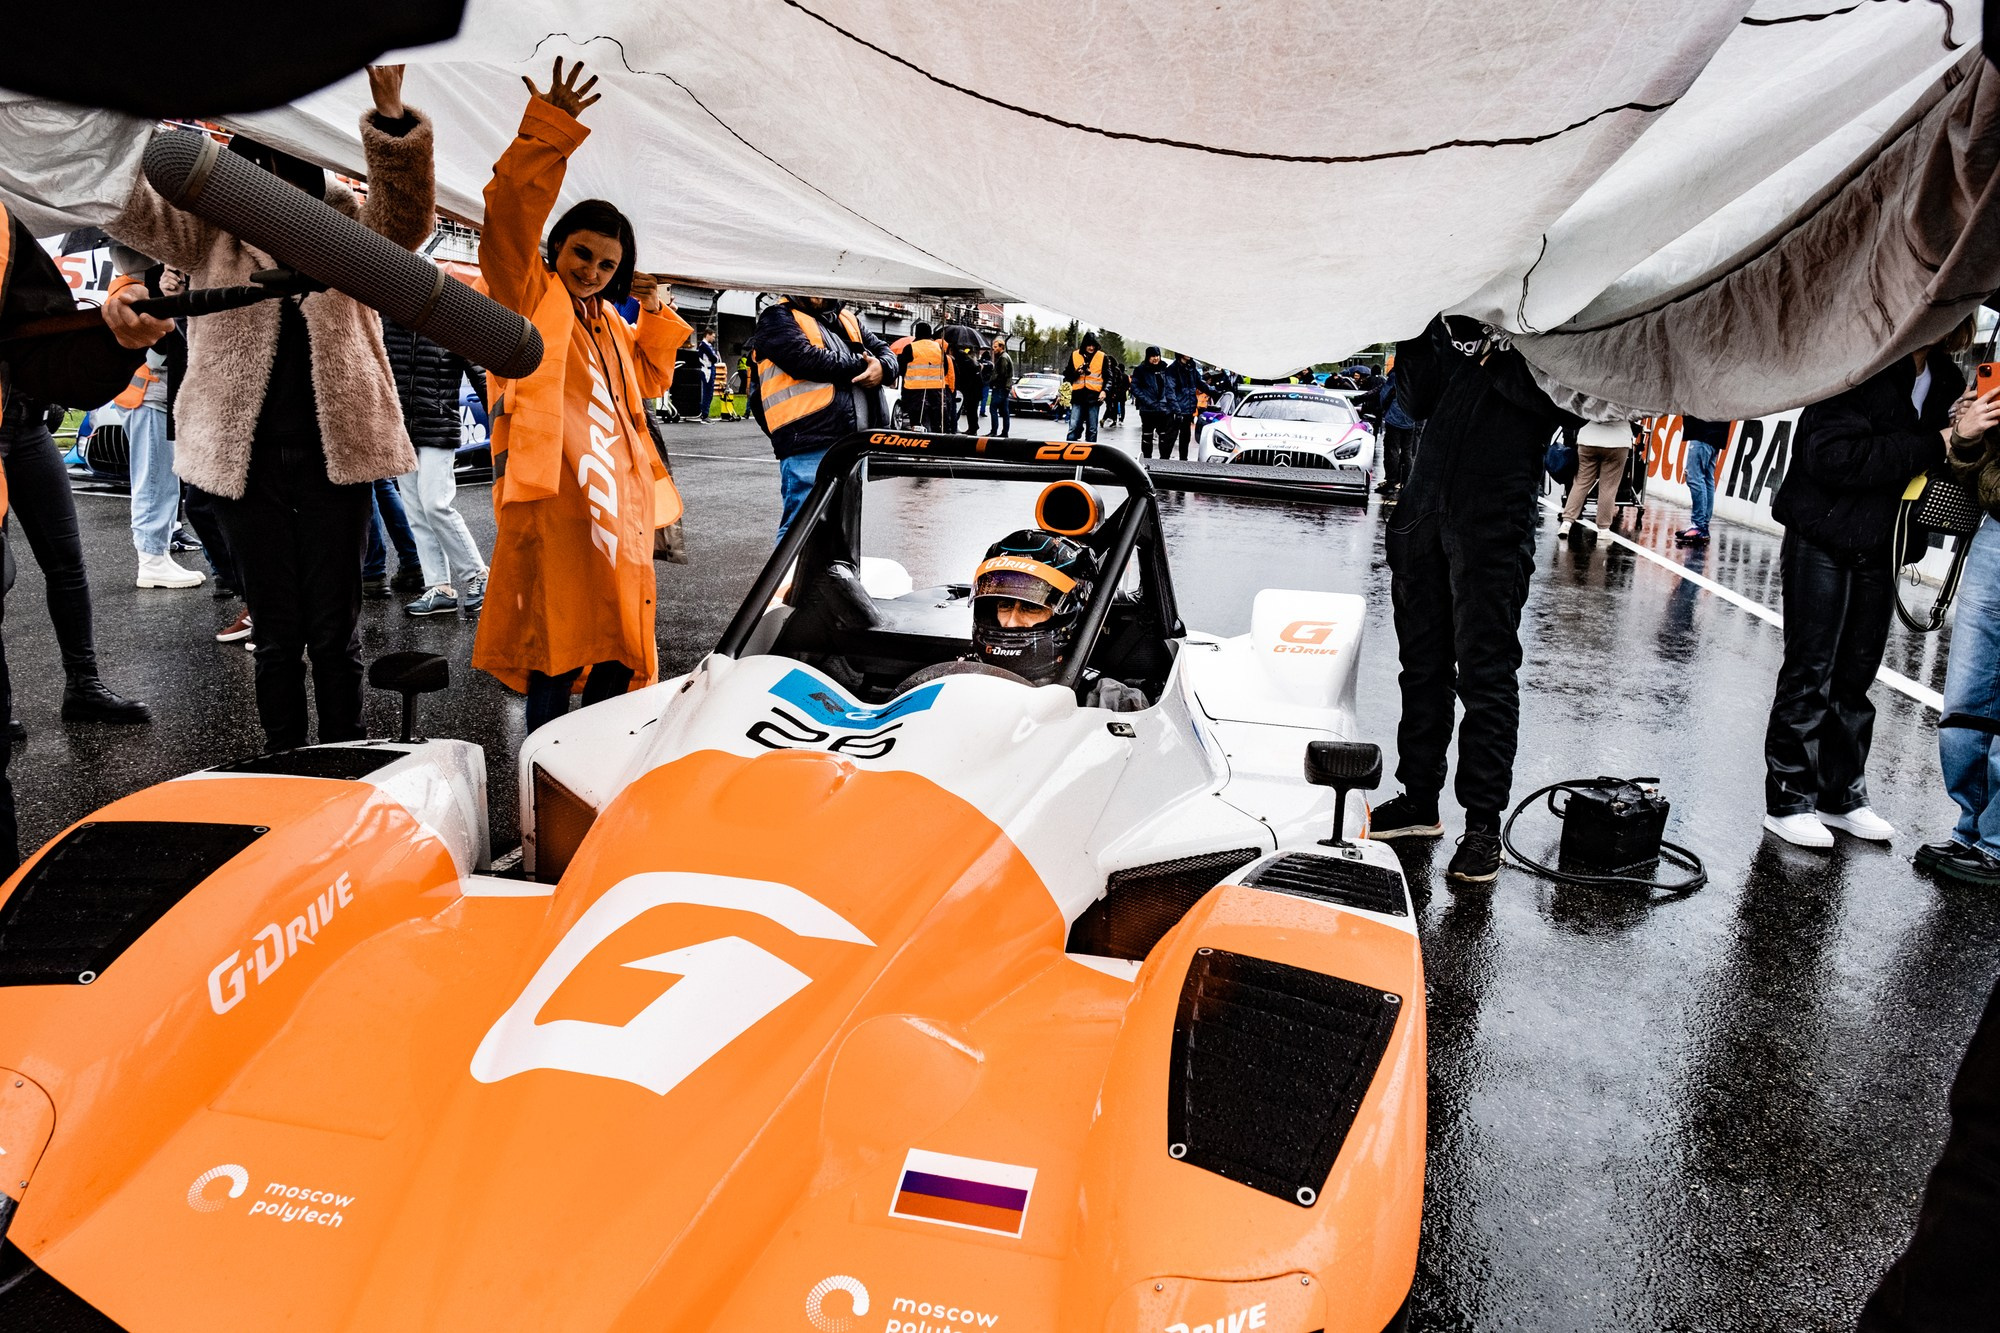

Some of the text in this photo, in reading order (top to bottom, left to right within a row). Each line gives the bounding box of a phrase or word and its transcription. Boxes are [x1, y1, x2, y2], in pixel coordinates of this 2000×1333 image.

[1035, 441, 1093, 461] 26
[264, 1182, 356, 1208] moscow
[248, 1200, 343, 1228] polytech
[892, 1297, 999, 1328] moscow
